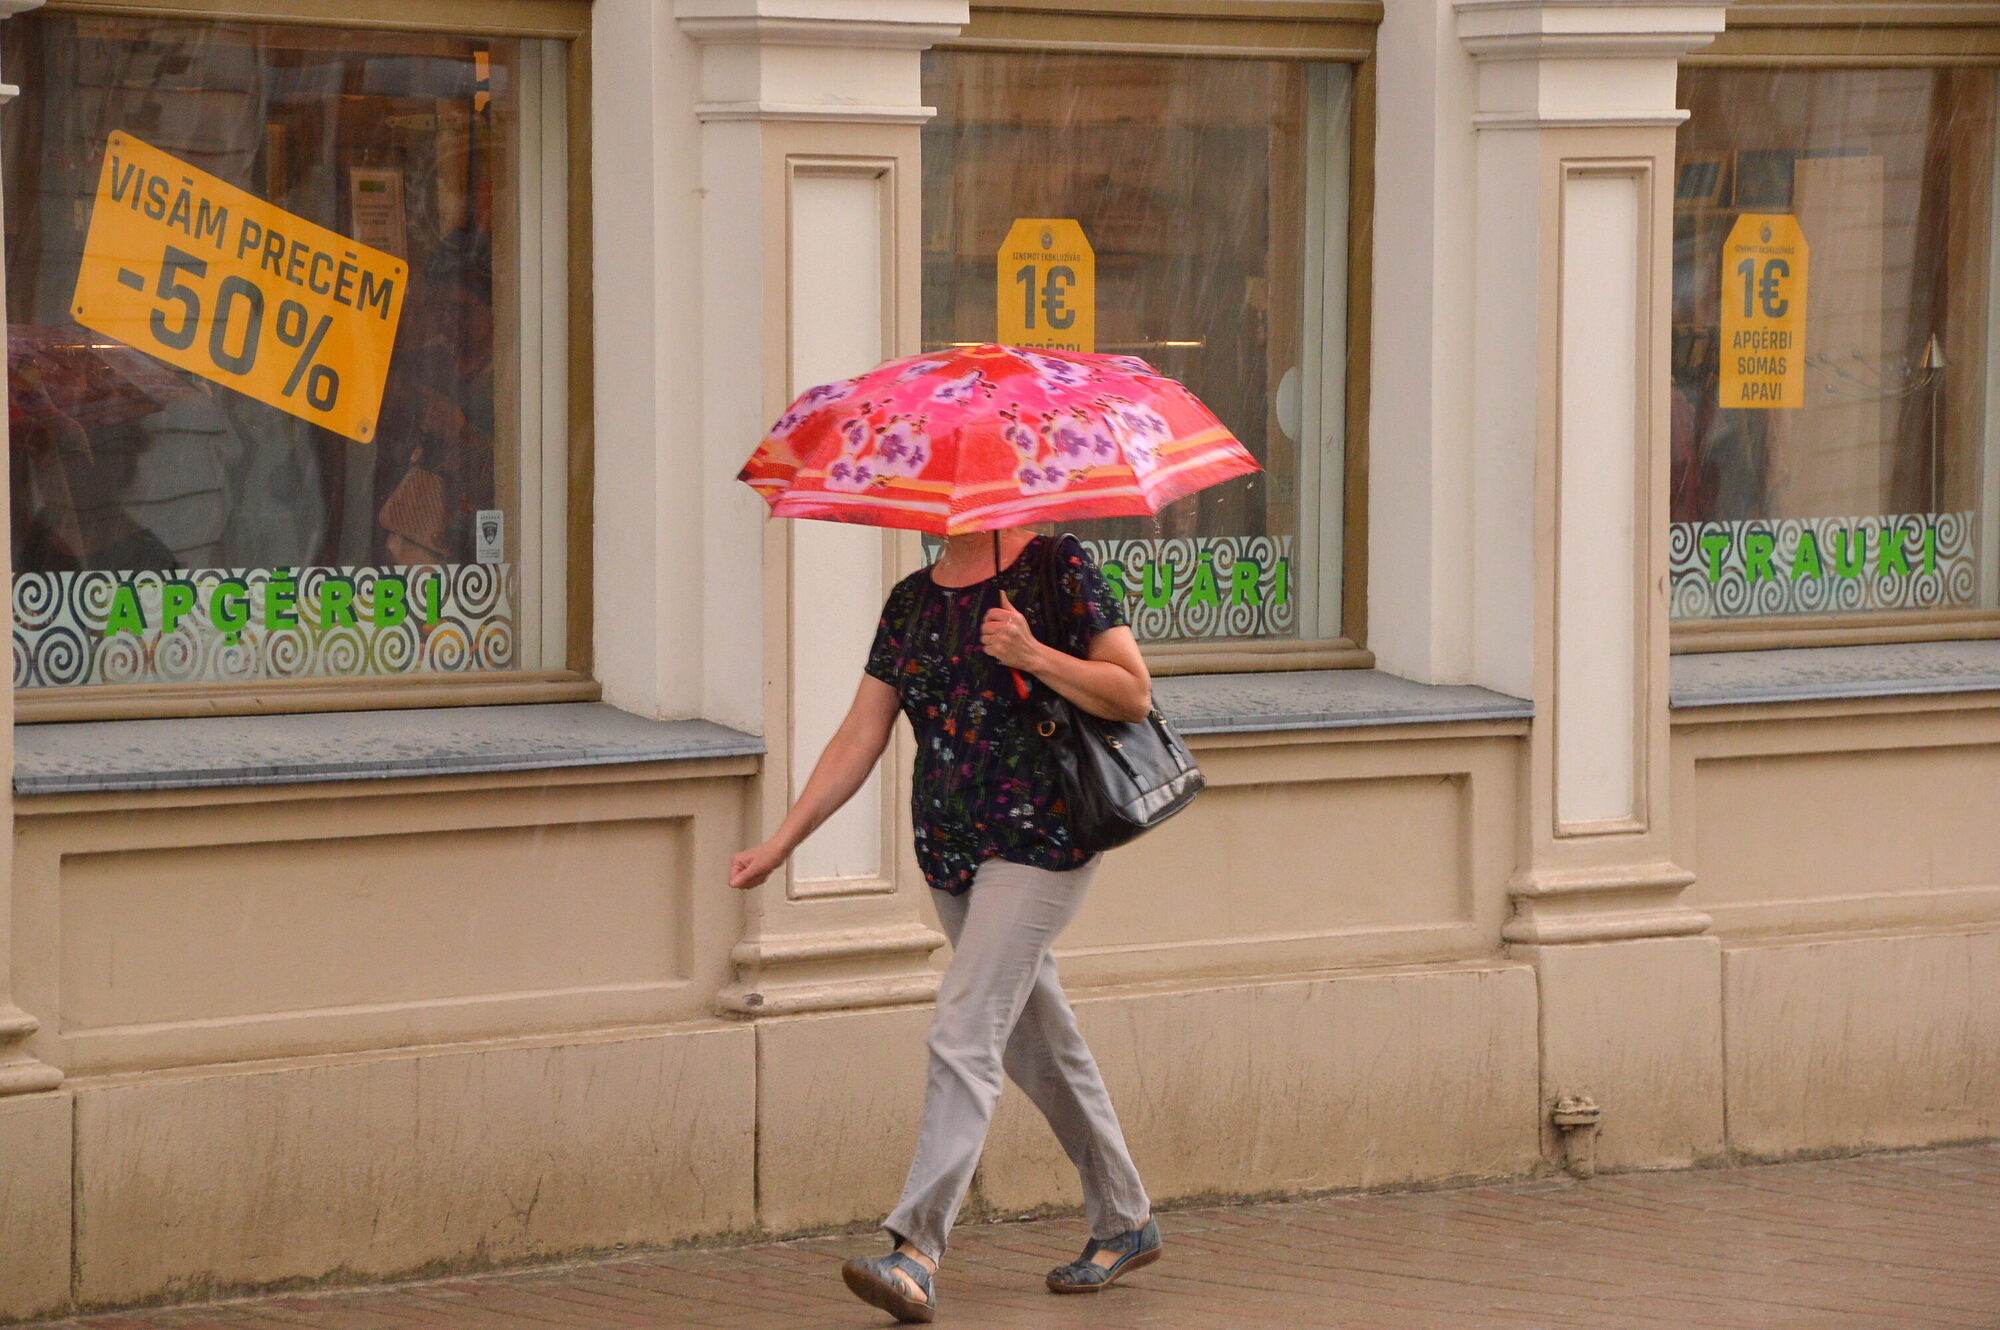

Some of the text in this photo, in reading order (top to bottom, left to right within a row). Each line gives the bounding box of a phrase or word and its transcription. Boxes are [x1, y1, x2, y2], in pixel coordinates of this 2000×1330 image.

[110, 155, 229, 250] VISĀM
[236, 217, 395, 320] PRECĒM
[1016, 264, 1076, 330] 1€
[1737, 257, 1790, 319] 1€
[117, 244, 340, 413] -50%
[1733, 326, 1793, 354] APĢĒRBI
[1737, 356, 1787, 376] SOMAS
[1741, 382, 1782, 401] APAVI
[1700, 525, 1936, 583] TRAUKI
[104, 567, 443, 647] APĢĒRBI
